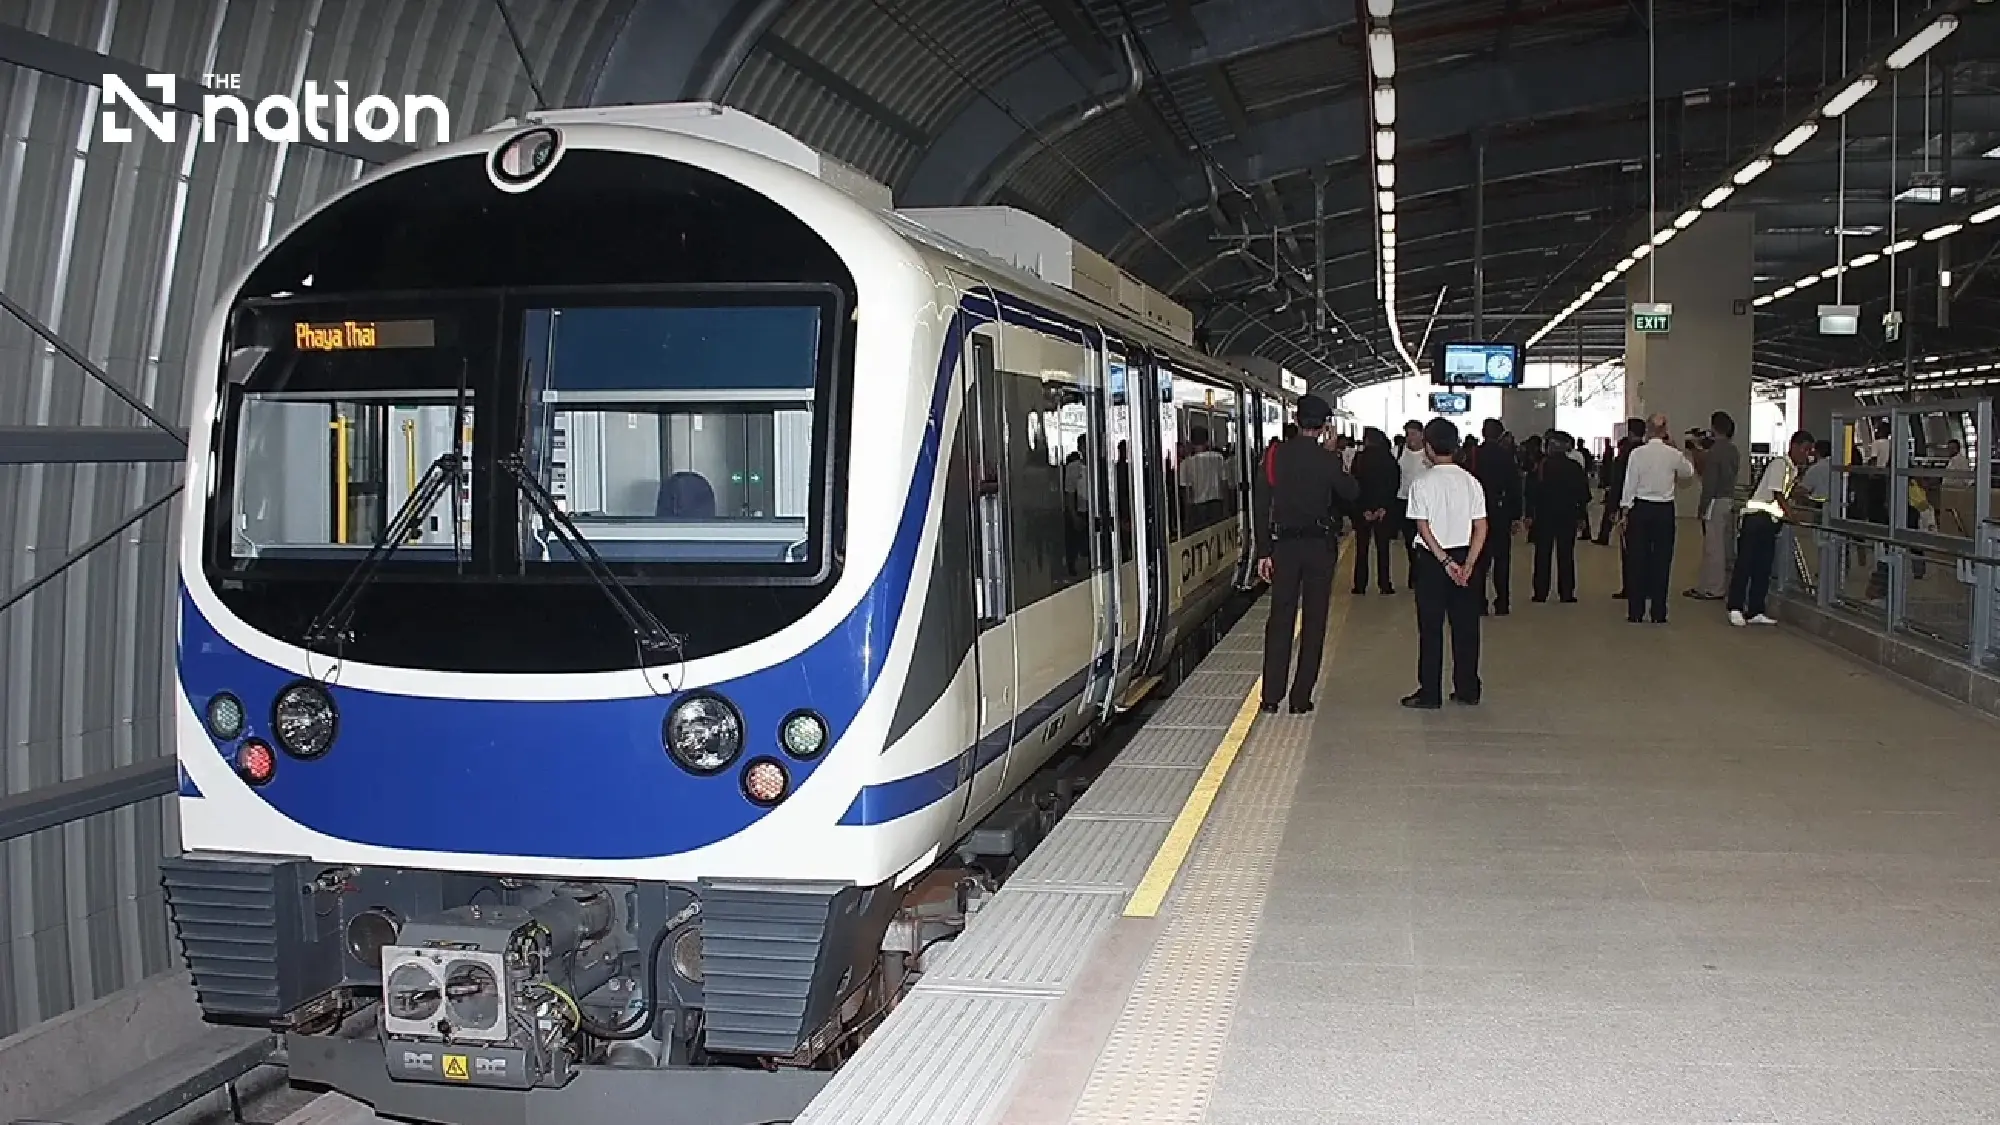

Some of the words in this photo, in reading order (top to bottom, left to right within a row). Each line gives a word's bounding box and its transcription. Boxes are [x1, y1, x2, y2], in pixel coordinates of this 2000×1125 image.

[296, 322, 342, 350] Phaya
[345, 321, 375, 347] Thai
[1636, 316, 1667, 329] EXIT
[1181, 536, 1214, 583] CITY
